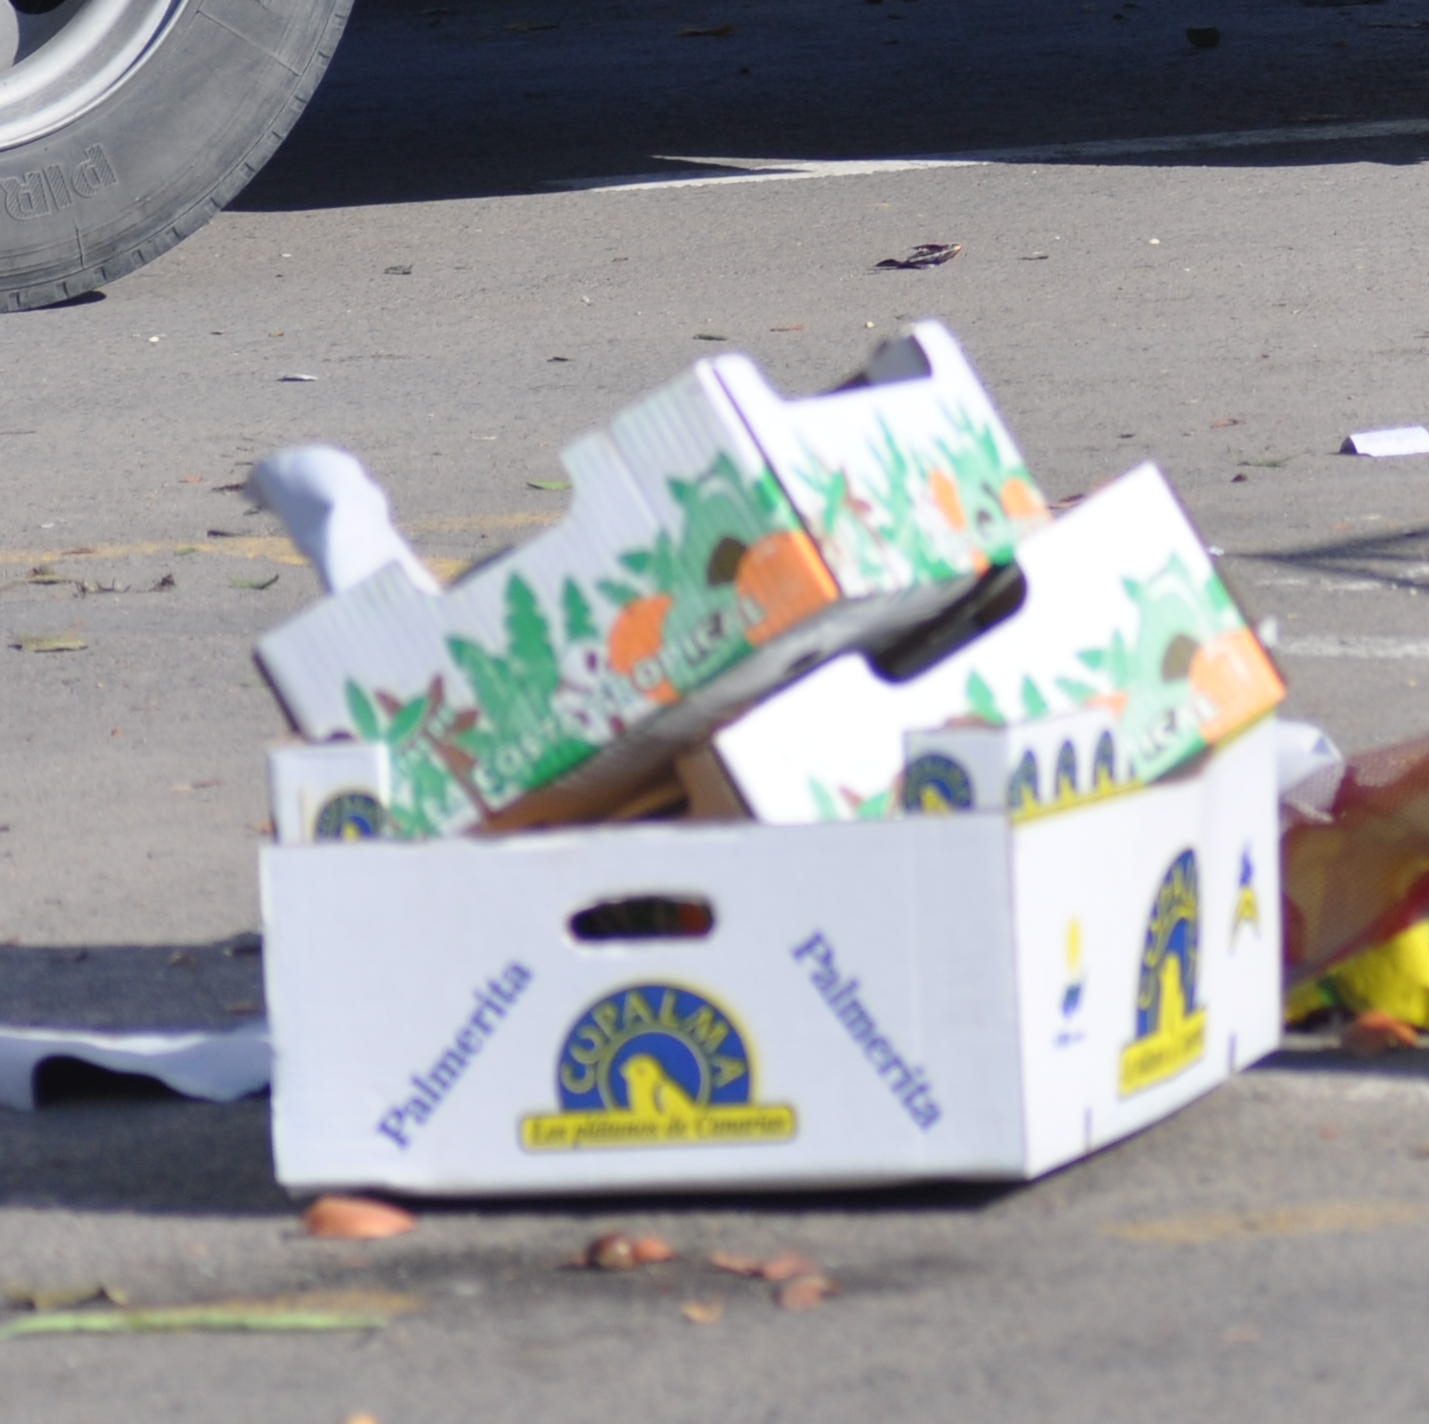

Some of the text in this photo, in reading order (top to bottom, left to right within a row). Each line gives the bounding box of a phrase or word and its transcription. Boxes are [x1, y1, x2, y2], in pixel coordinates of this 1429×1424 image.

[376, 959, 533, 1149] Palmerita
[561, 988, 747, 1095] COPALMA
[792, 930, 942, 1132] Palmerita
